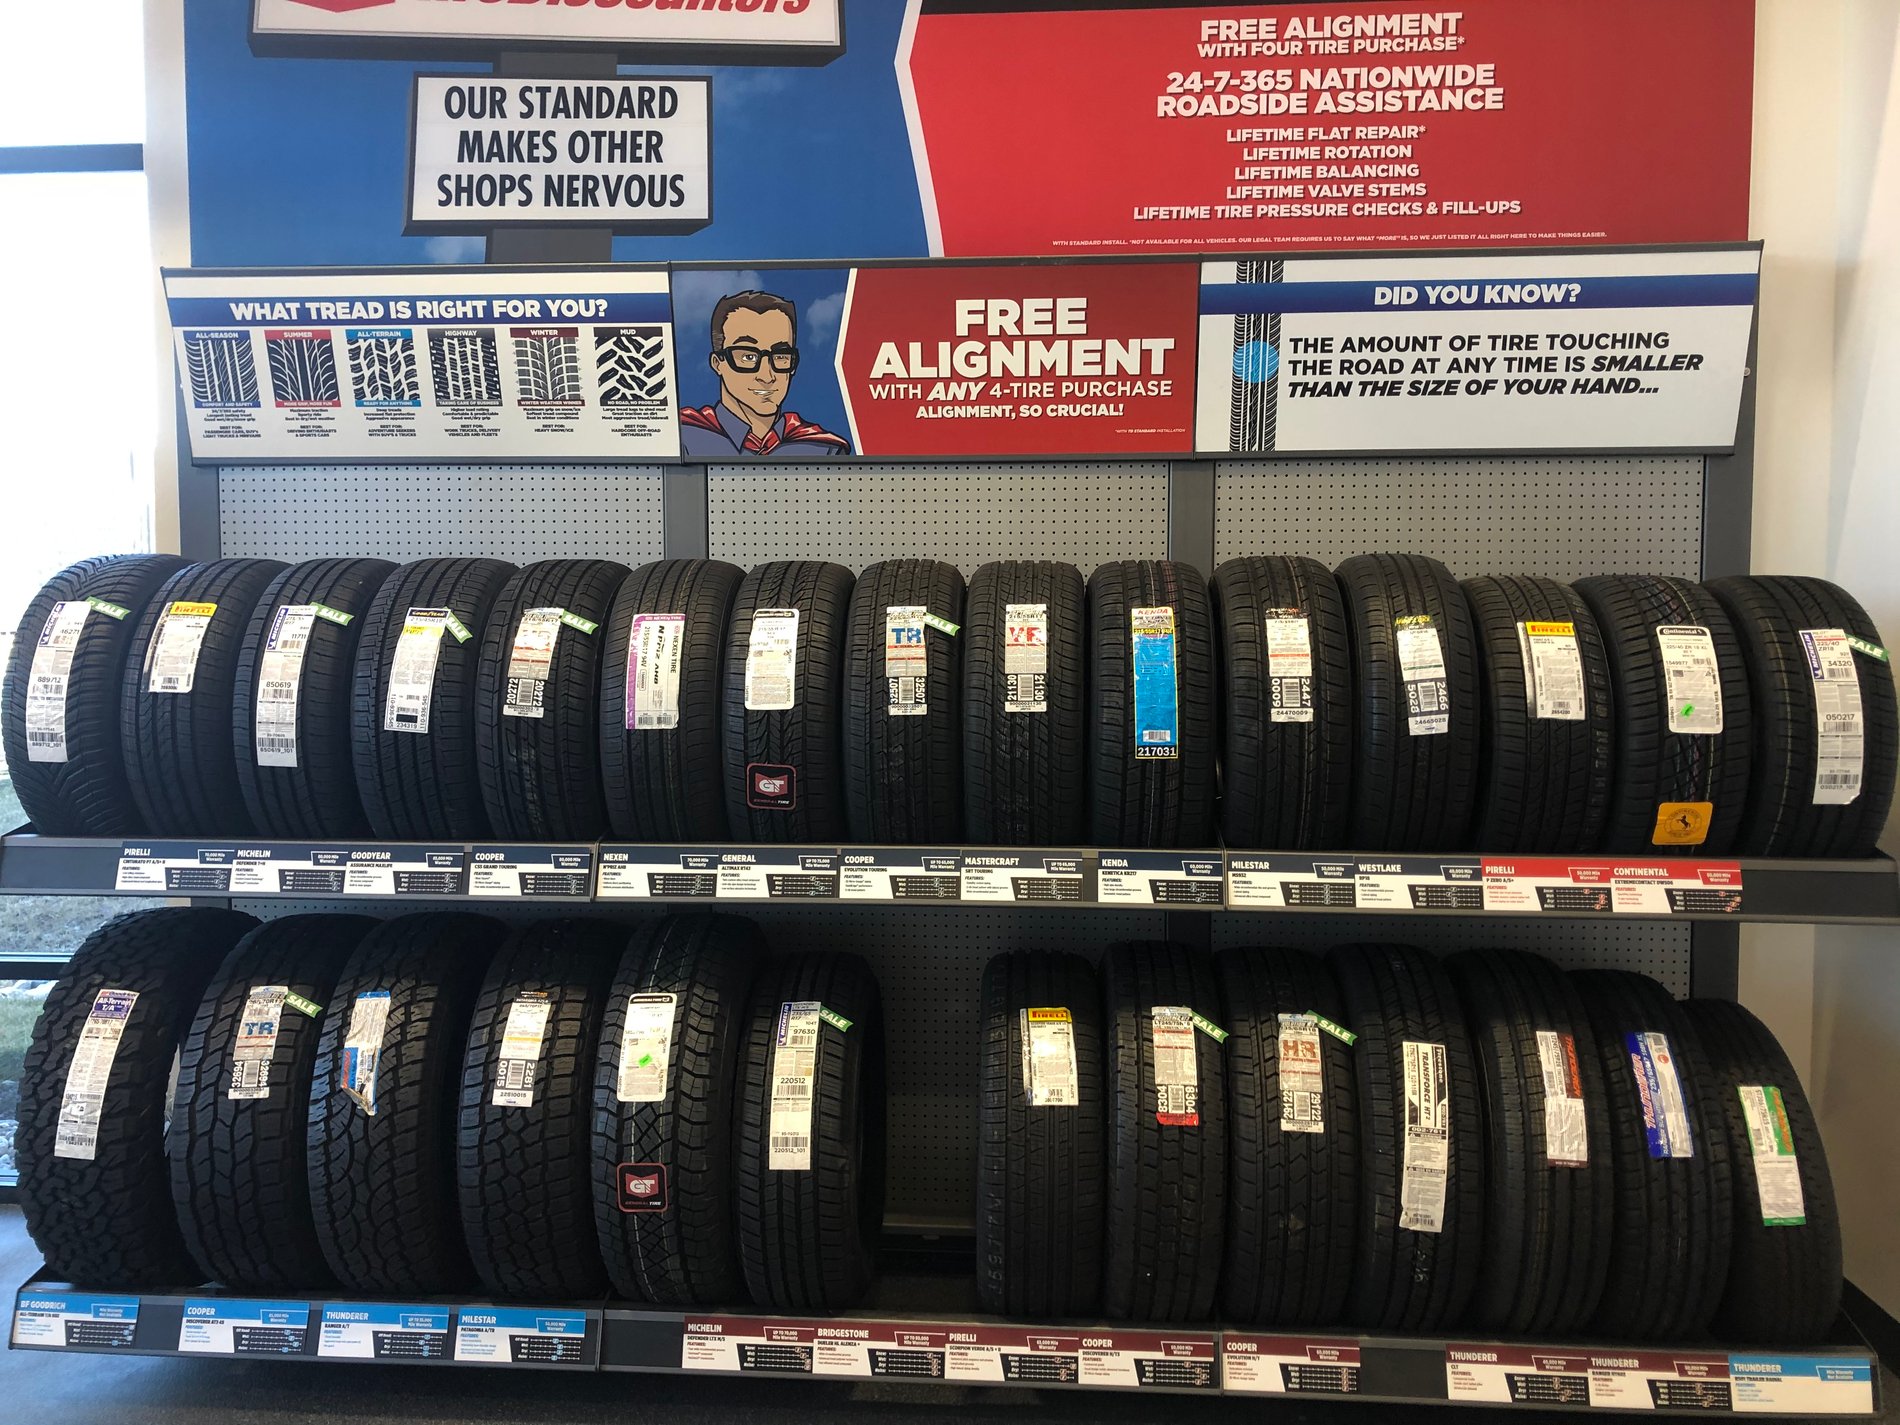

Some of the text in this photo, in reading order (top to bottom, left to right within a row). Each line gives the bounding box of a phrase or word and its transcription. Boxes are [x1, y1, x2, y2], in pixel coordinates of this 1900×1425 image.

[1201, 12, 1462, 41] FREE ALIGNMENT
[1197, 42, 1246, 57] WITH
[1251, 40, 1302, 55] FOUR
[1306, 39, 1349, 54] TIRE
[1166, 63, 1494, 93] 24-7-365 NATIONWIDE
[444, 85, 678, 119] OUR STANDARD
[1157, 87, 1503, 117] ROADSIDE ASSISTANCE
[1226, 127, 1304, 142] LIFETIME
[1307, 126, 1351, 140] FLAT
[457, 130, 663, 163] MAKES OTHER
[1243, 144, 1411, 160] LIFETIME ROTATION
[1234, 163, 1419, 179] LIFETIME BALANCING
[437, 173, 685, 207] SHOPS NERVOUS
[1226, 182, 1426, 198] LIFETIME VALVE STEMS
[1133, 200, 1521, 219] LIFETIME TIRE PRESSURE CHECKS & FILL-UPS
[1374, 283, 1581, 305] DID YOU KNOW?
[229, 298, 607, 320] WHAT TREAD IS RIGHT FOR YOU?
[955, 297, 1087, 336] FREE
[283, 331, 312, 340] SUMMER
[357, 331, 404, 339] ALL-TERRAIN
[530, 329, 558, 338] WINTER
[620, 329, 639, 337] MUD
[1289, 331, 1669, 354] THE AMOUNT OF TIRE TOUCHING
[869, 337, 1174, 383] ALIGNMENT
[1288, 354, 1703, 376] THE ROAD AT ANY TIME IS SMALLER
[868, 380, 1172, 401] WITH ANY 4-TIRE PURCHASE
[1288, 377, 1659, 397] THAN THE SIZE OF YOUR HAND...
[915, 403, 1123, 419] ALIGNMENT, SO CRUCIAL!
[320, 608, 349, 623] SALE
[563, 615, 592, 630] SALE
[673, 635, 681, 659] NEXEN
[1849, 637, 1884, 656] SALE
[266, 681, 292, 689] 850619
[506, 678, 518, 704] 20272
[889, 678, 898, 703] 32507
[1007, 674, 1017, 700] 21130
[533, 680, 545, 707] 20272
[1825, 713, 1855, 721] 050217
[1137, 747, 1176, 757] 217031
[124, 848, 150, 856] PIRELLI
[237, 849, 271, 857] MICHELIN
[351, 851, 391, 859] GOODYEAR
[475, 852, 504, 861] COOPER
[603, 853, 628, 861] NEXEN
[721, 854, 756, 862] GENERAL
[844, 855, 874, 863] COOPER
[965, 857, 1019, 865] MASTERCRAFT
[1101, 858, 1128, 867] KENDA
[1231, 860, 1269, 869] MILESTAR
[1358, 863, 1401, 872] WESTLAKE
[1485, 865, 1514, 874] PIRELLI
[1613, 867, 1668, 876] CONTINENTAL
[287, 995, 316, 1012] SALE
[820, 1009, 846, 1027] SALE
[244, 1021, 275, 1035] TR
[1193, 1016, 1222, 1038] SALE
[1319, 1020, 1351, 1041] SALE
[20, 1300, 65, 1309] BF GOODRICH
[187, 1306, 215, 1315] COOPER
[326, 1311, 368, 1320] THUNDERER
[461, 1315, 496, 1324] MILESTAR
[687, 1323, 722, 1332] MICHELIN
[817, 1327, 869, 1338] BRIDGESTONE
[949, 1332, 976, 1342] PIRELLI
[1082, 1338, 1112, 1347] COOPER
[1226, 1342, 1257, 1351] COOPER
[1450, 1351, 1497, 1362] THUNDERER
[1590, 1357, 1639, 1368] THUNDERER
[1733, 1363, 1781, 1372] THUNDERER
